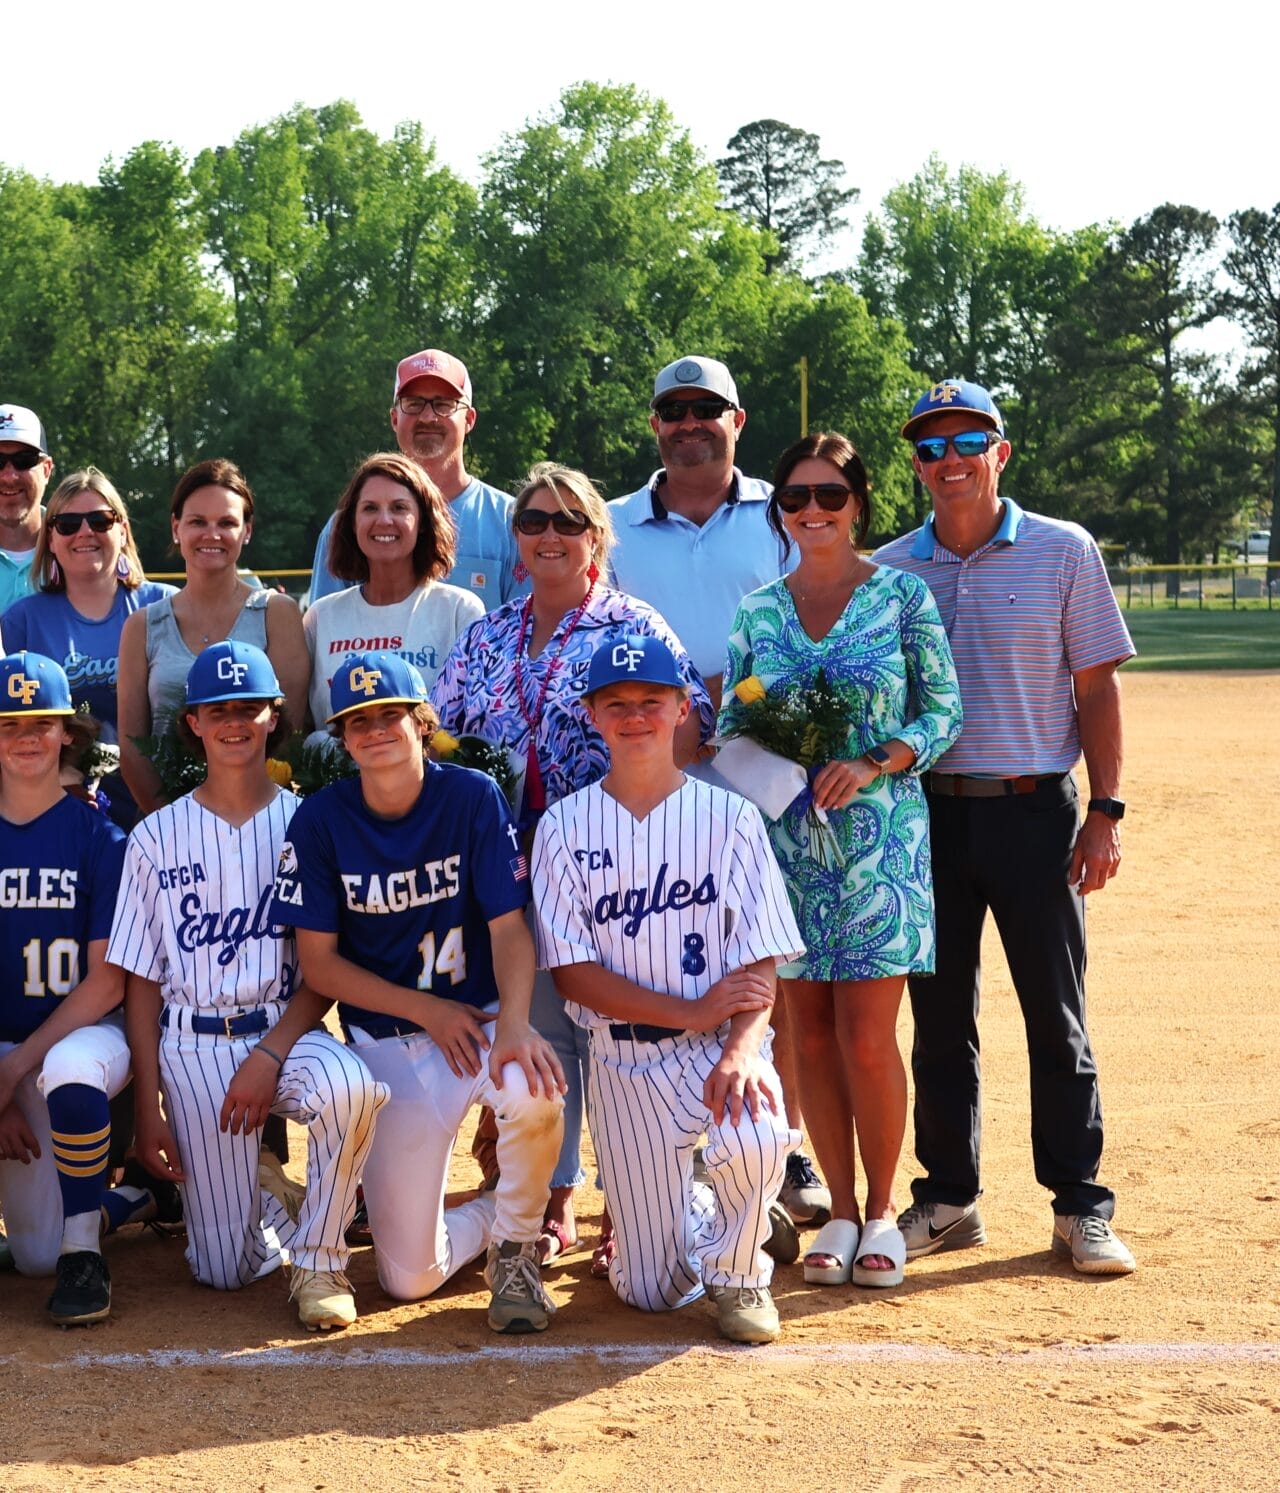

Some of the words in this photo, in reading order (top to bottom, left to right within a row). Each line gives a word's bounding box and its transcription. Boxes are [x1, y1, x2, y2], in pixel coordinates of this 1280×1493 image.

[929, 383, 962, 403] CF
[329, 636, 402, 655] moms
[612, 643, 645, 672] CF
[217, 656, 249, 686] CF
[349, 665, 382, 696] CF
[7, 673, 40, 705] CF
[158, 862, 206, 890] CFCA
[340, 854, 461, 914] EAGLES
[594, 862, 719, 940] agles
[22, 938, 80, 998] 10
[416, 925, 468, 991] 14
[682, 932, 706, 977] 8
